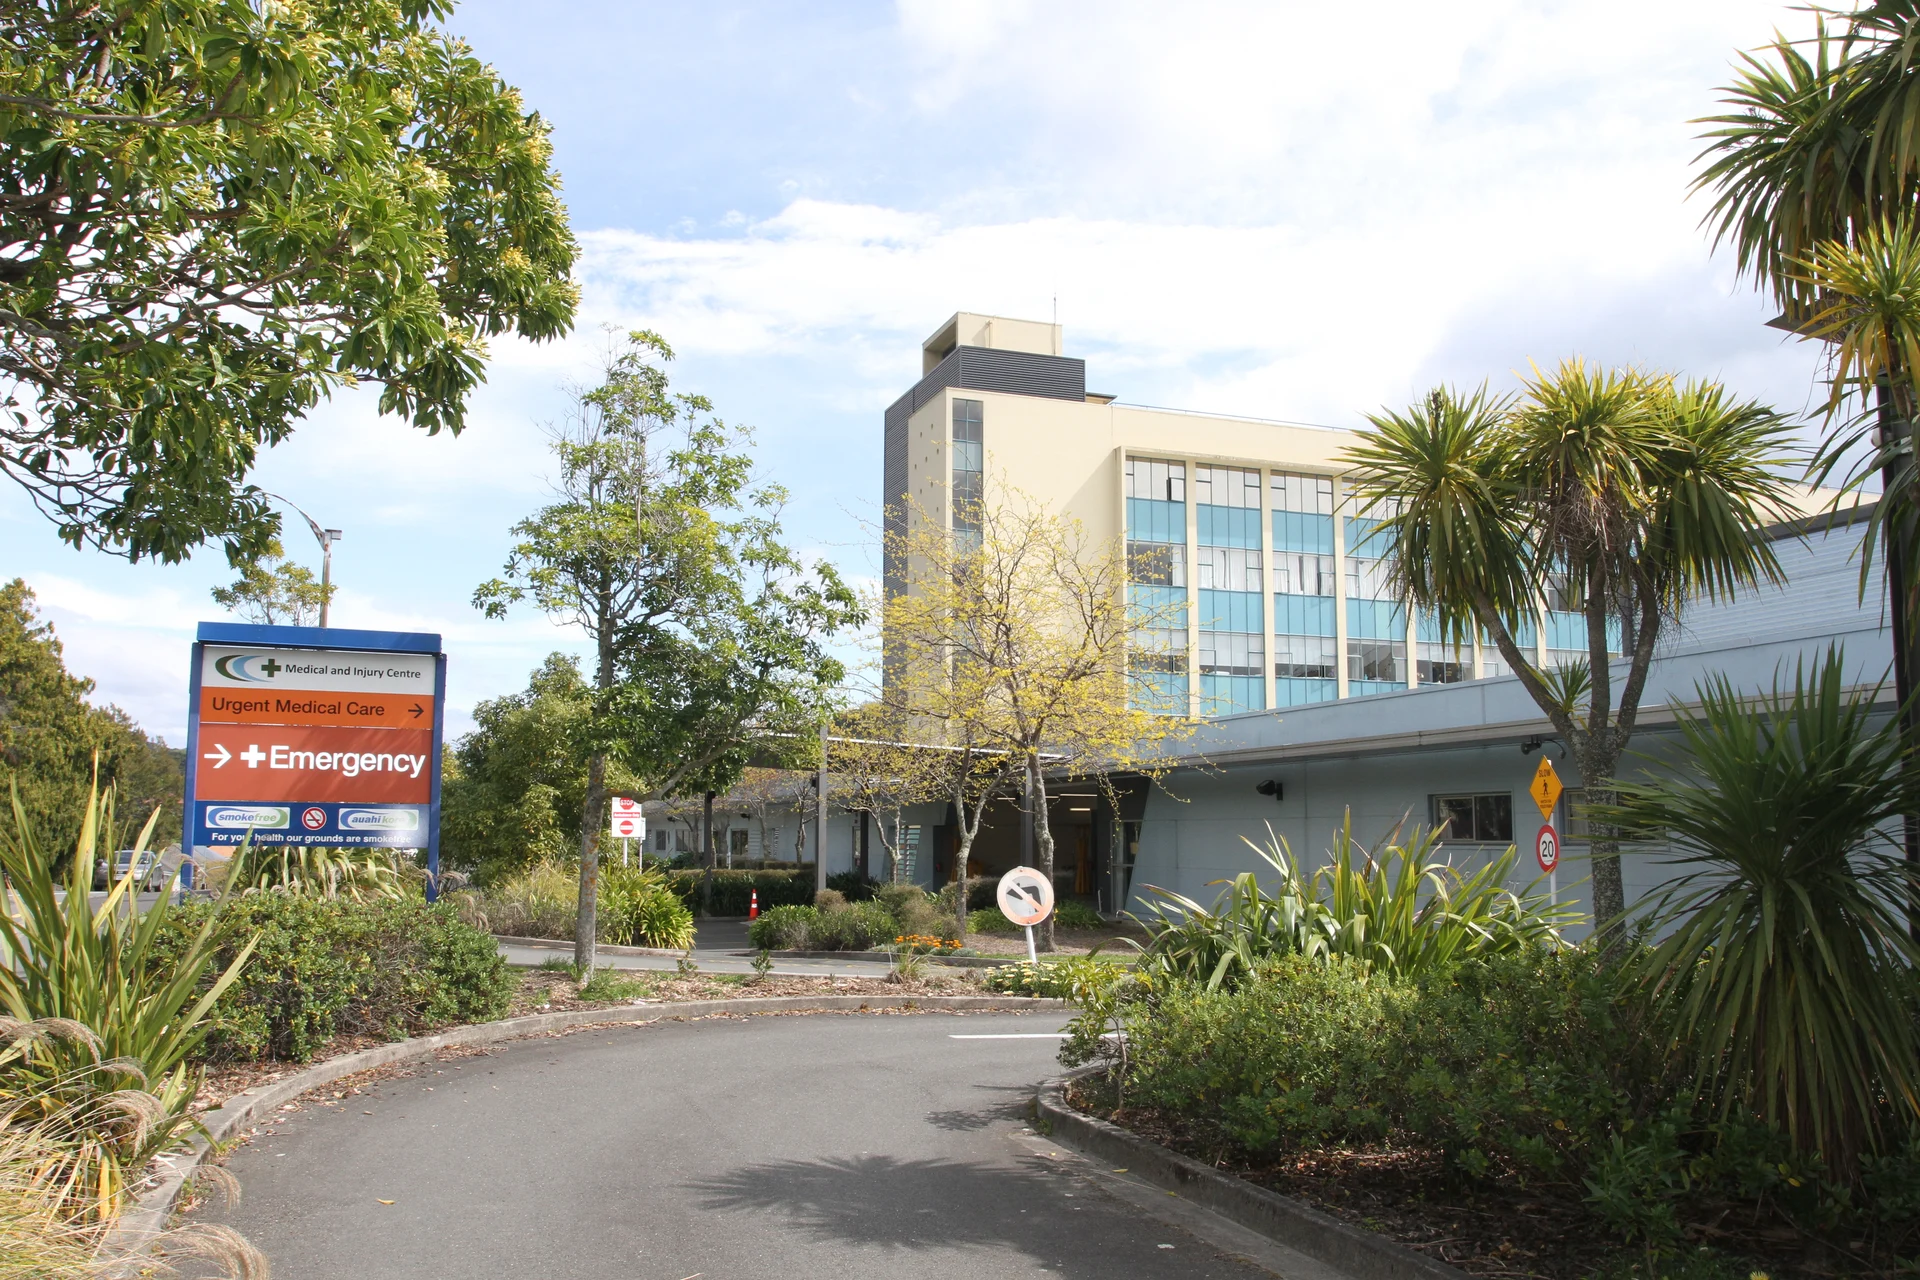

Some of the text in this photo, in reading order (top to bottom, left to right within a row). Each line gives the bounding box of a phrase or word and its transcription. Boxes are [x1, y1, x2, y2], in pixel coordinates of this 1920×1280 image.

[285, 664, 421, 678] Medical and Injury Centre
[212, 697, 385, 716] Urgent Medical Care
[269, 745, 426, 779] Emergency
[1538, 769, 1551, 777] SLOW
[218, 813, 277, 822] smokefree
[351, 815, 381, 824] auahi
[211, 832, 229, 841] For
[230, 834, 252, 843] yo
[304, 834, 344, 844] grounds
[346, 835, 361, 843] are
[1541, 840, 1554, 858] 20
